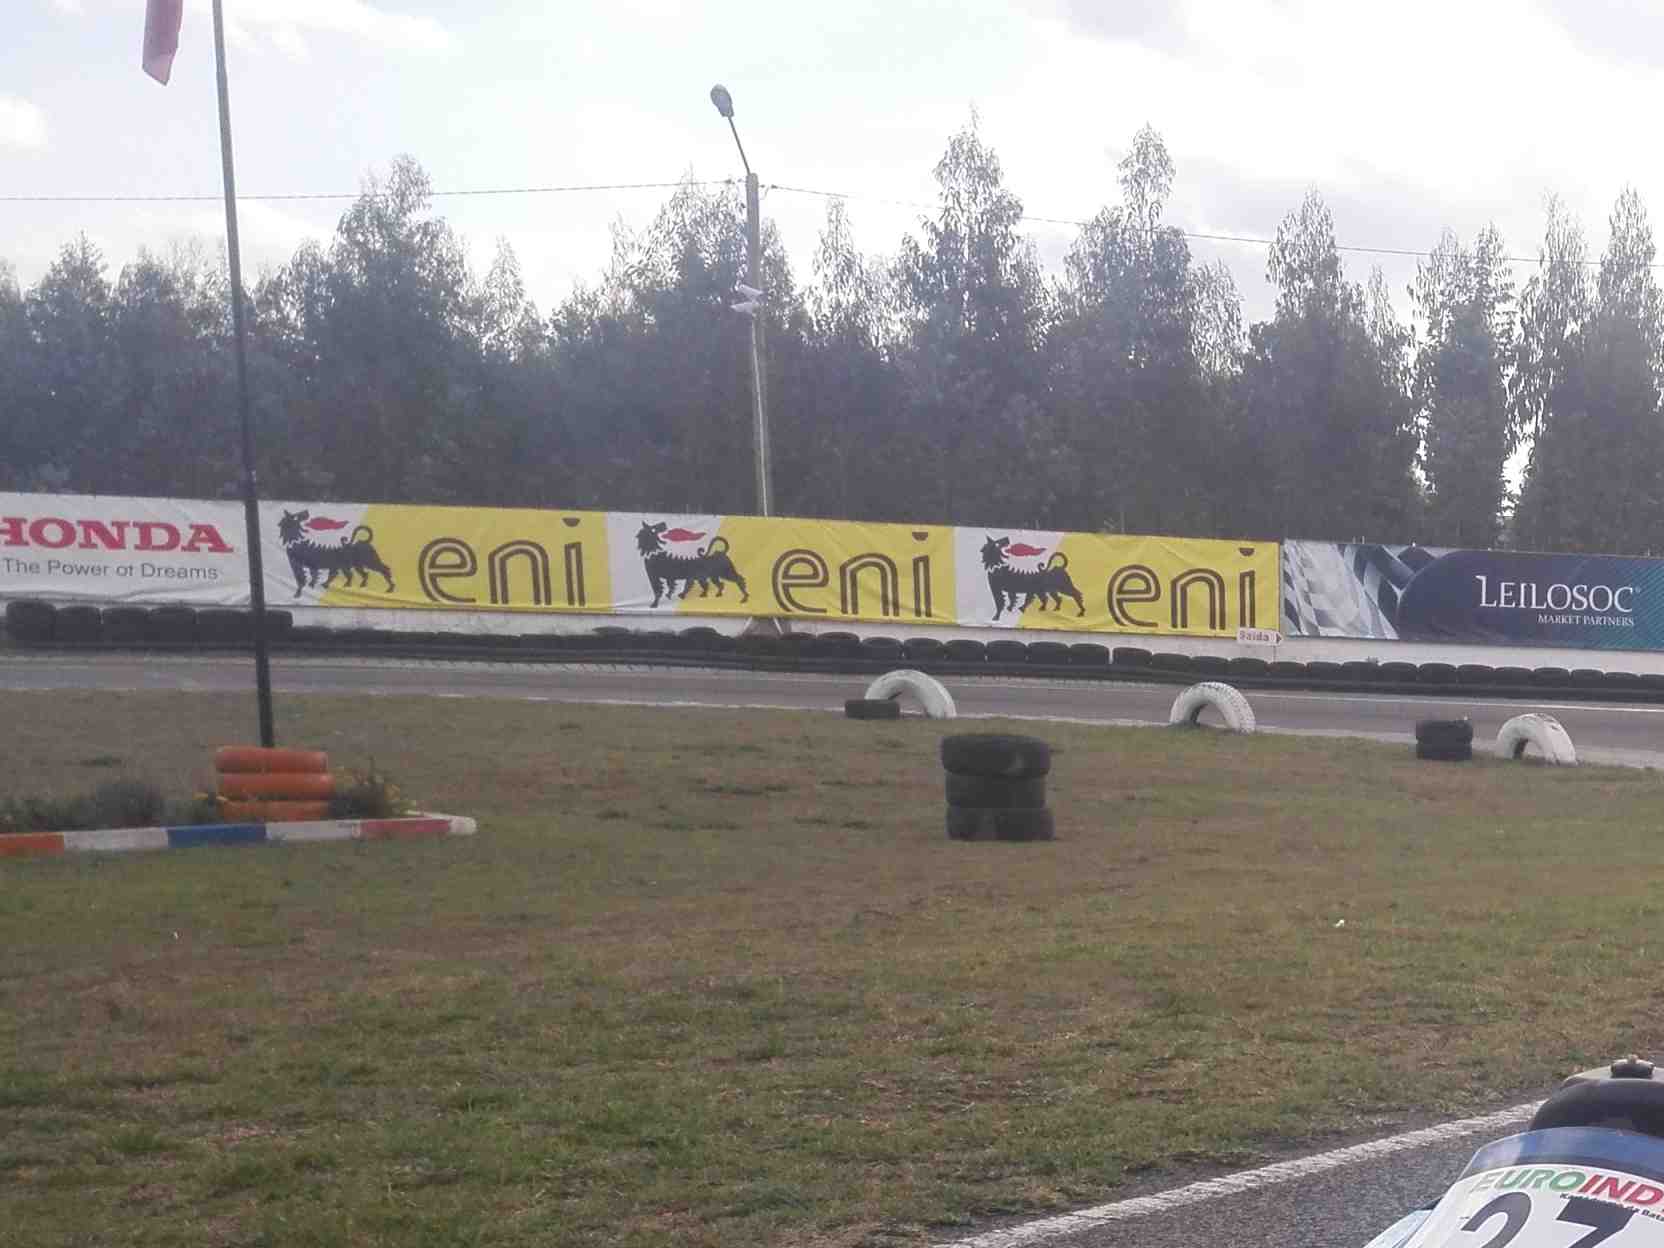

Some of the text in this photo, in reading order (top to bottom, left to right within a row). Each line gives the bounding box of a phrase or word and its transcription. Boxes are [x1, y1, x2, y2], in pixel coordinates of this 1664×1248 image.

[4, 558, 218, 580] The Power of Dreams
[418, 516, 586, 606] eni
[771, 531, 933, 618] eni
[1107, 547, 1256, 630] eni
[1475, 575, 1634, 613] LEILOSOC
[1537, 613, 1634, 627] MARKET PARTNERS
